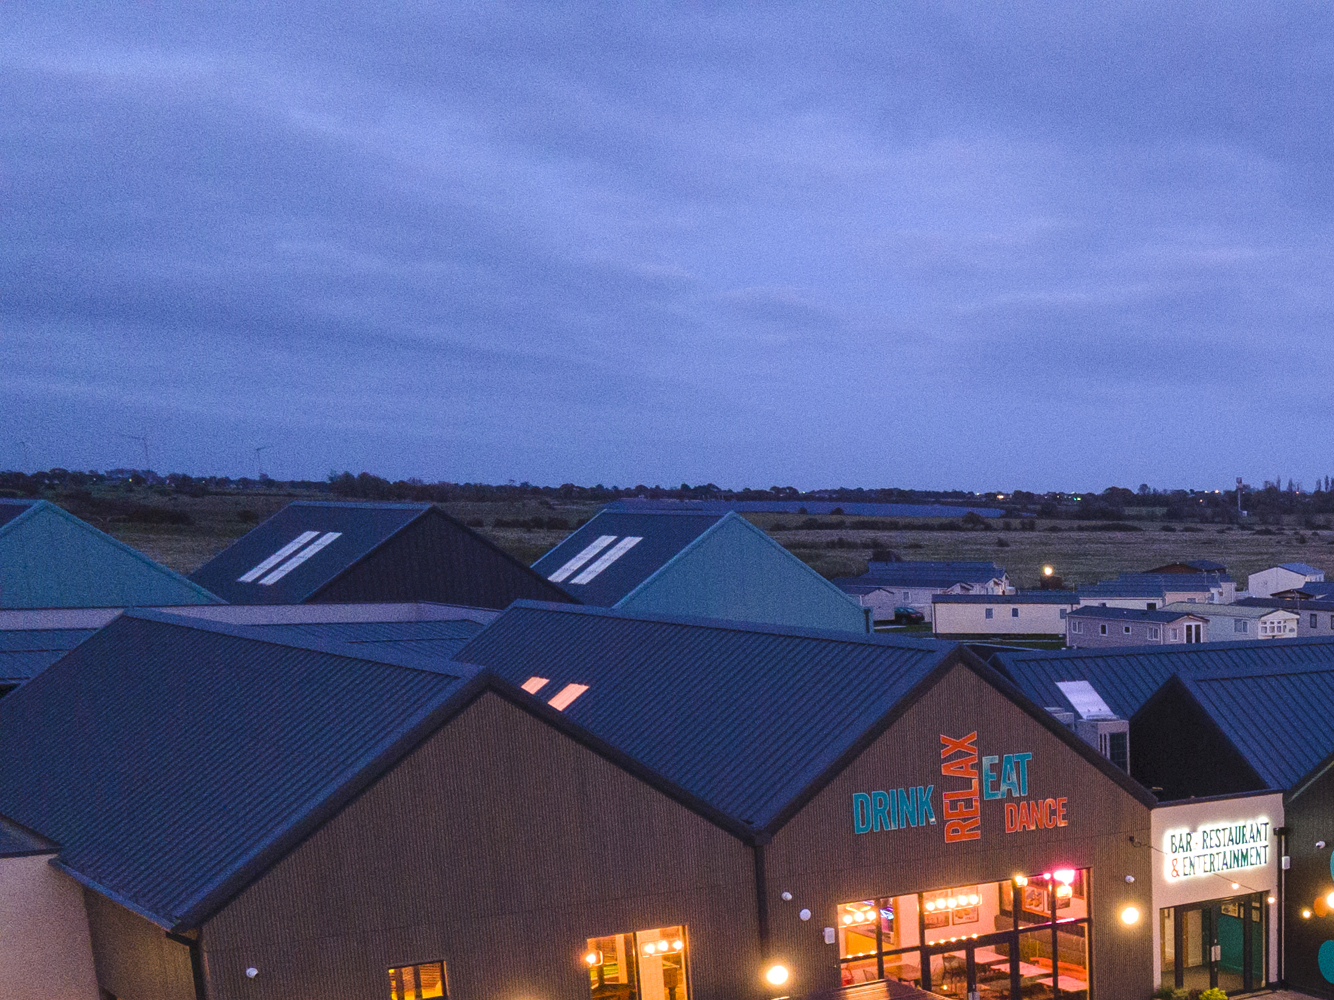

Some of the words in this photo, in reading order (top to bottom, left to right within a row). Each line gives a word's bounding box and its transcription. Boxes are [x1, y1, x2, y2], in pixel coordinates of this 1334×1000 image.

[940, 731, 981, 843] RELAX
[982, 752, 1032, 800] EAT
[853, 785, 936, 834] DRINK
[1005, 797, 1068, 833] DANCE
[1170, 832, 1193, 854] BAR
[1202, 822, 1269, 849] RESTAURANT
[1171, 858, 1180, 878] &
[1183, 845, 1269, 876] ENTERTAINMENT
